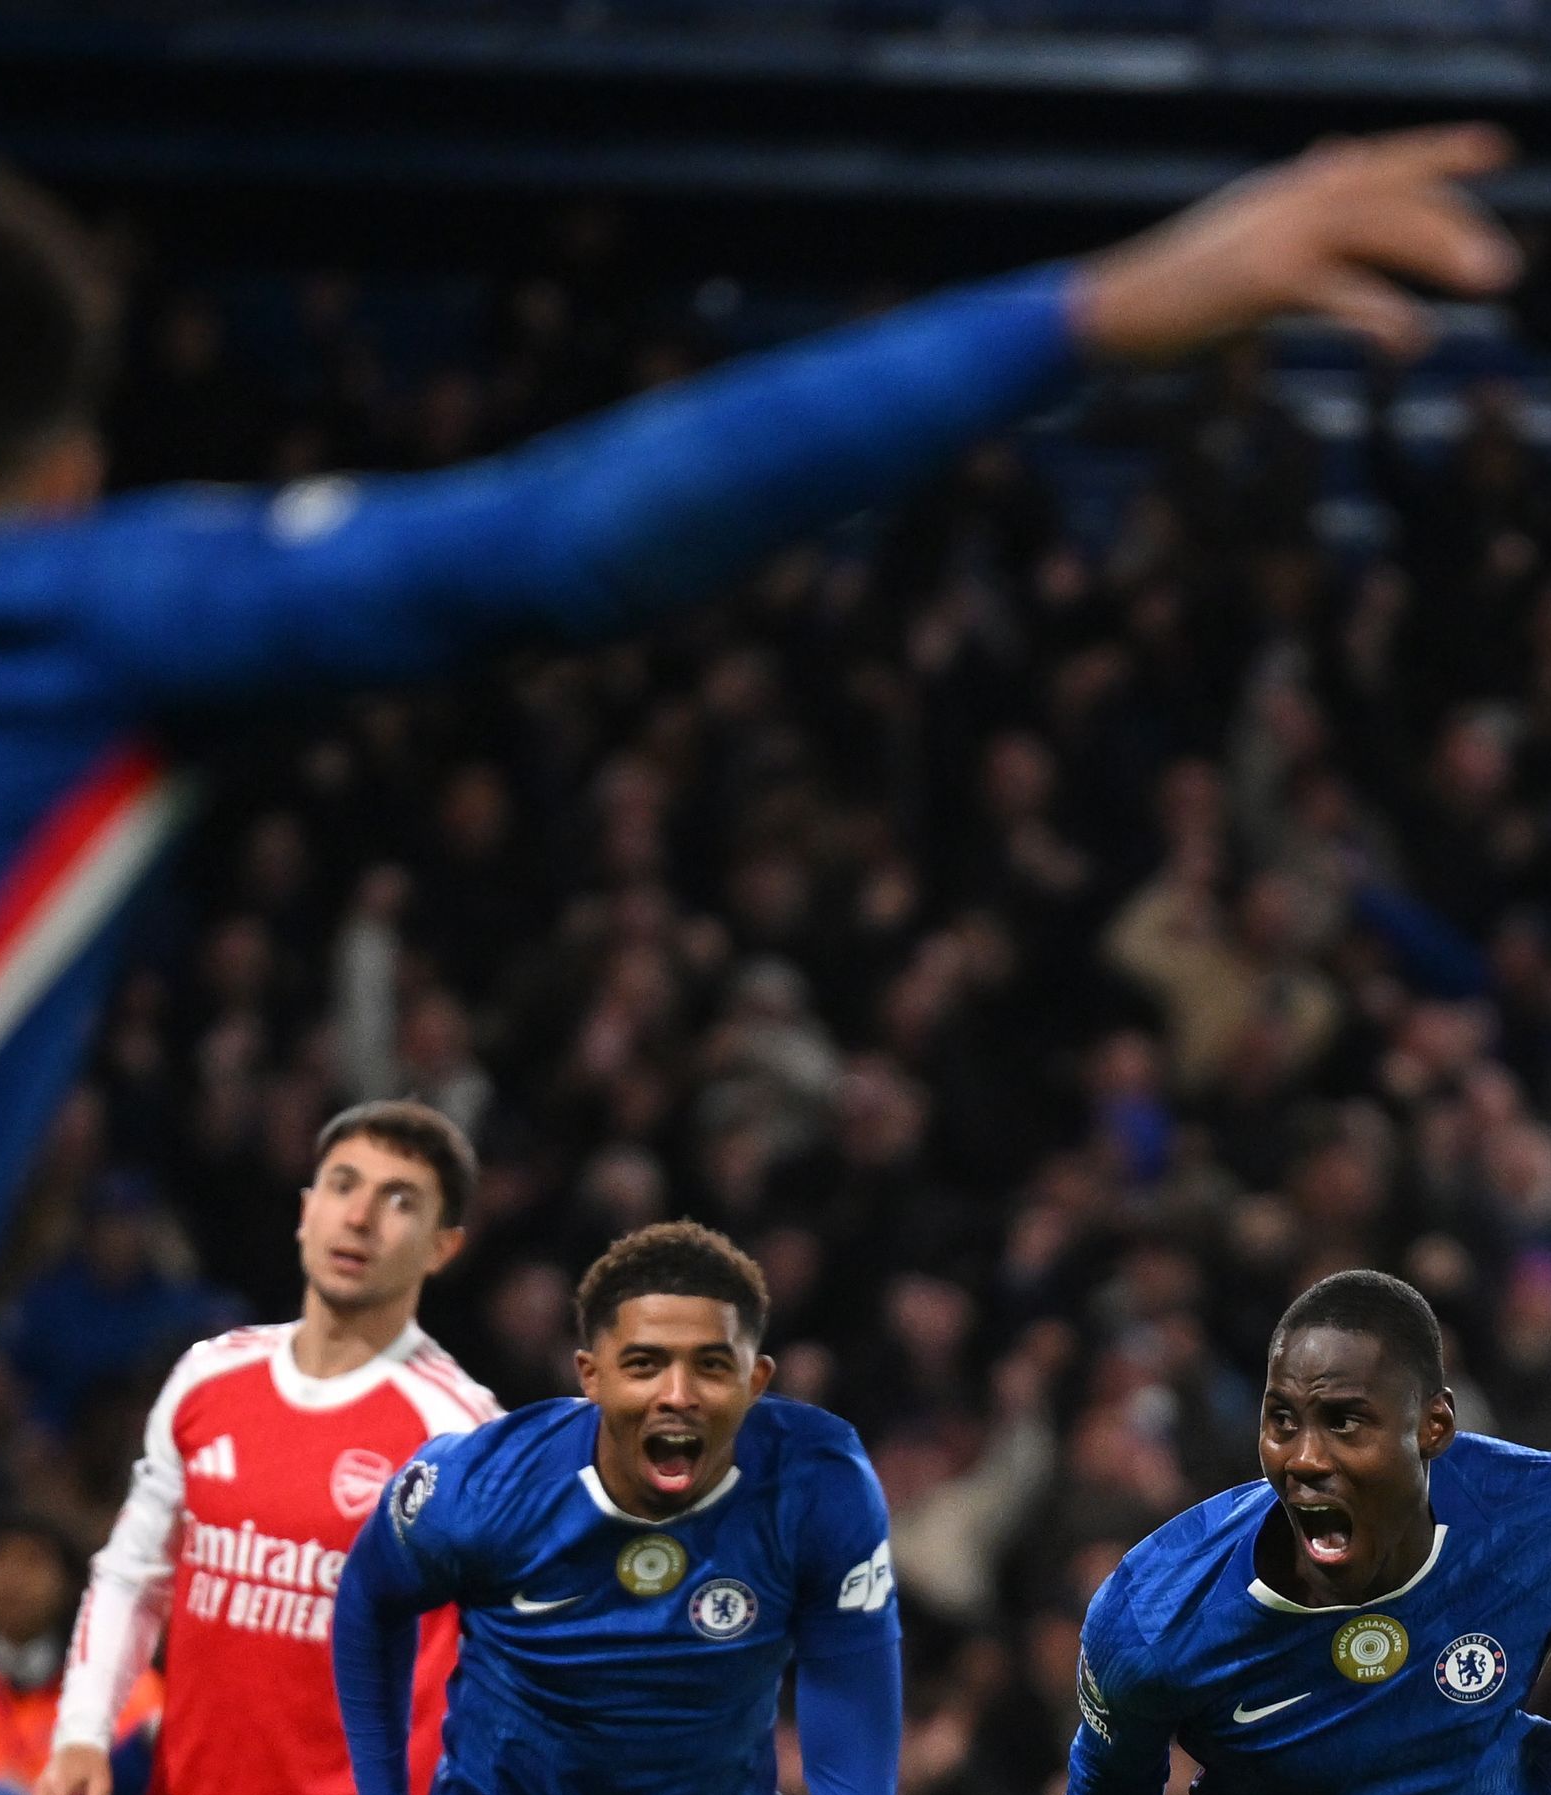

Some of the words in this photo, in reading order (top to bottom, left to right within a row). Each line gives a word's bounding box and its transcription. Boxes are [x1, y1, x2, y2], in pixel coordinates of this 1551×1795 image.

[181, 1512, 348, 1593] Emirate
[226, 1580, 334, 1642] BETTER
[1338, 1627, 1356, 1660] WORLD
[1357, 1620, 1402, 1652] CHAMPIONS
[1445, 1635, 1491, 1655] CHELSEA
[1357, 1666, 1386, 1678] FIFA
